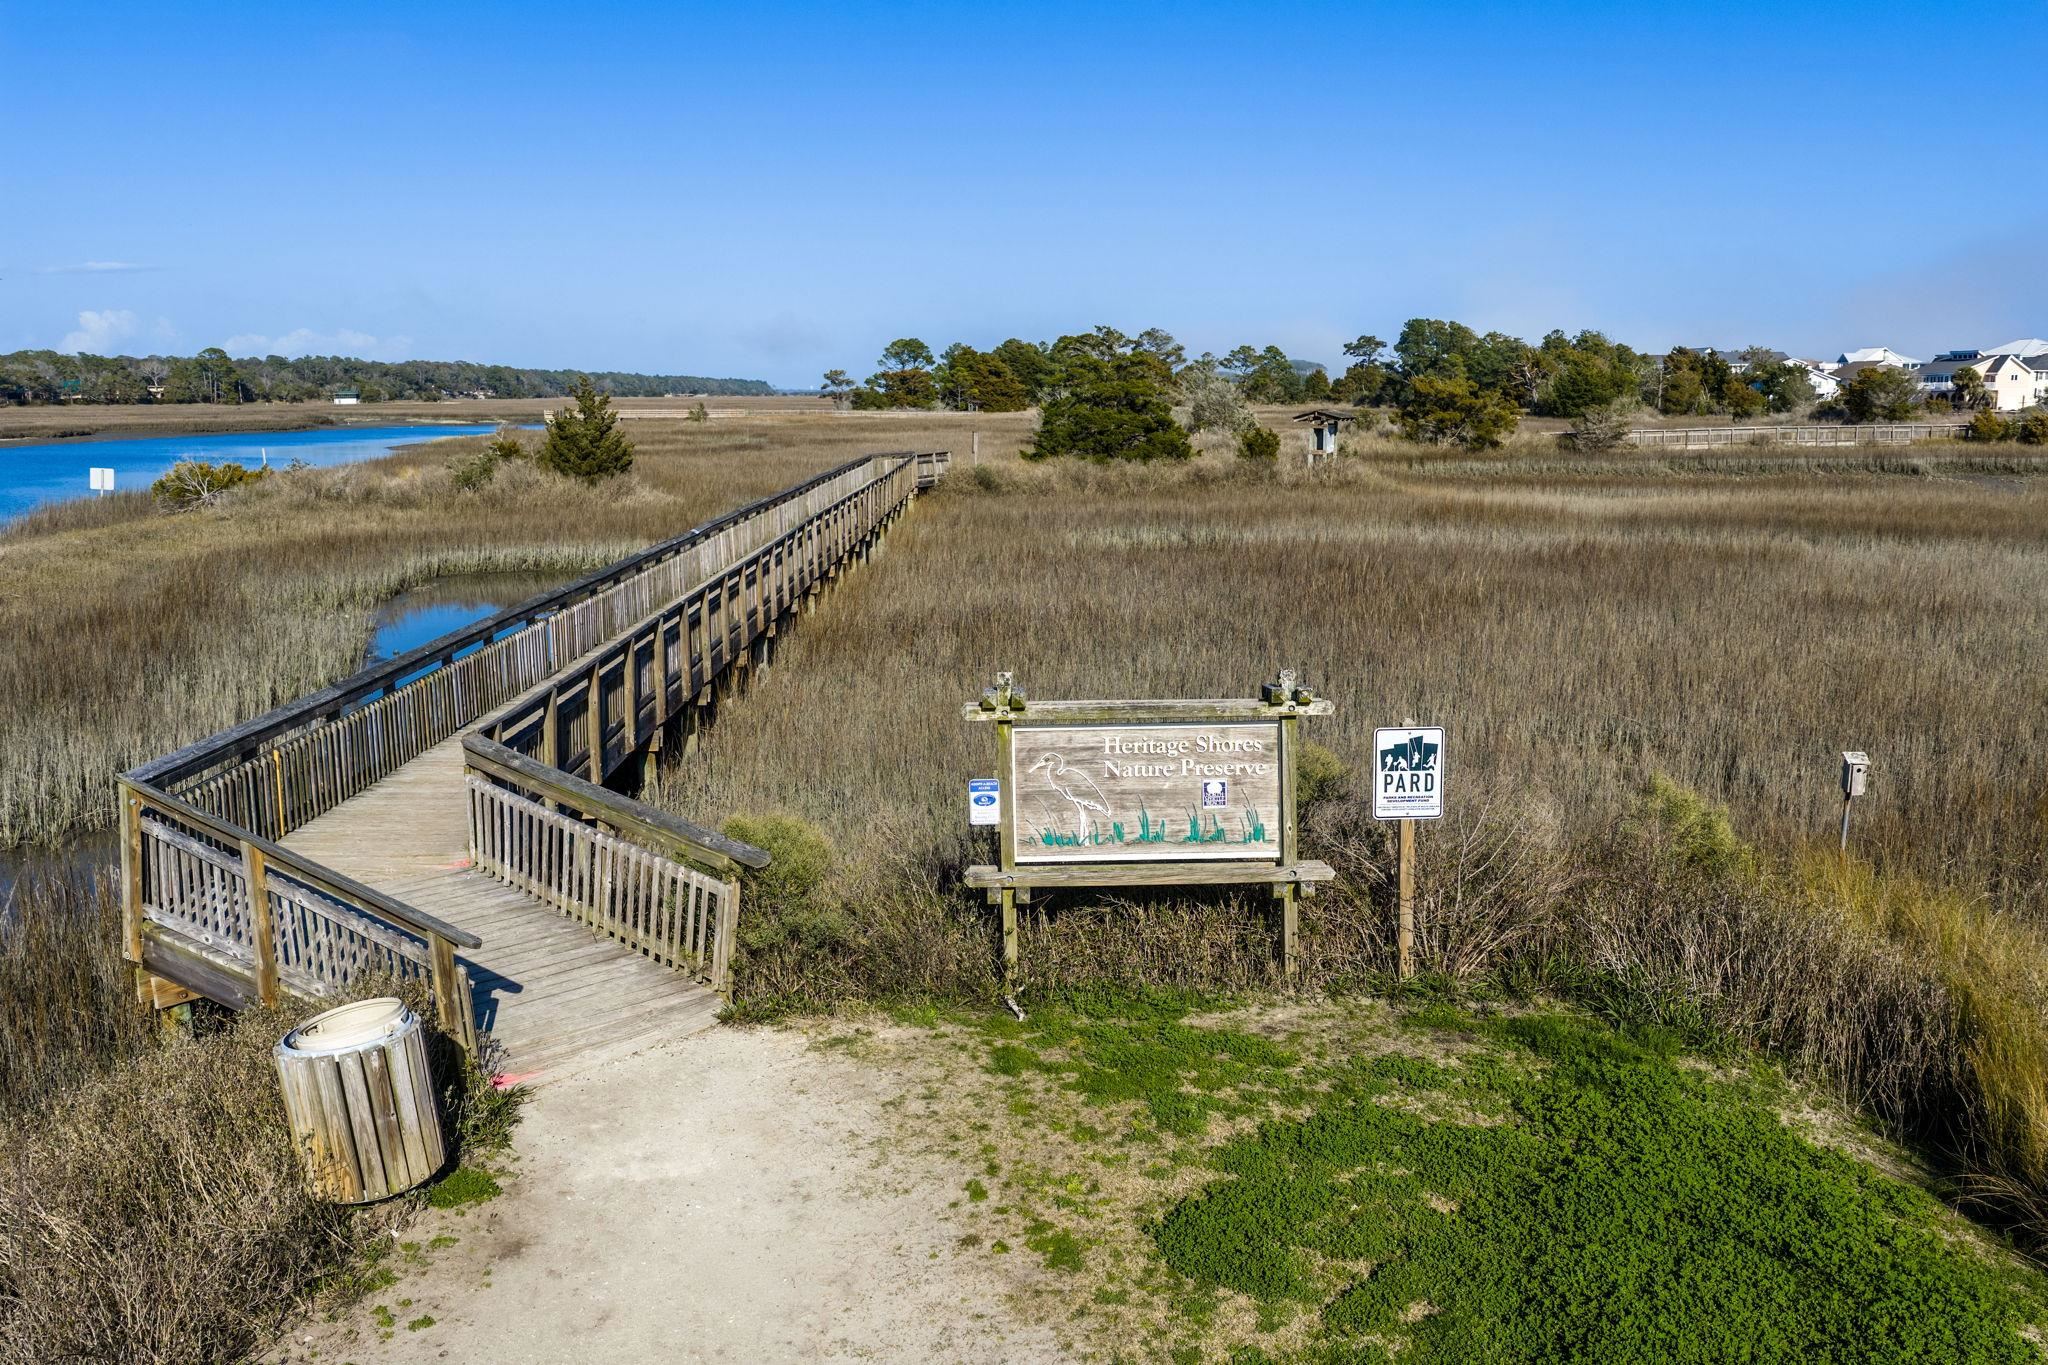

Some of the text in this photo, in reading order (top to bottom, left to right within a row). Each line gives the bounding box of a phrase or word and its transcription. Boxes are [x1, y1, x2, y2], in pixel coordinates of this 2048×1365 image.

[1103, 734, 1262, 757] Heritage Shores
[1103, 758, 1266, 778] Nature Preserve
[1384, 773, 1434, 793] PARD
